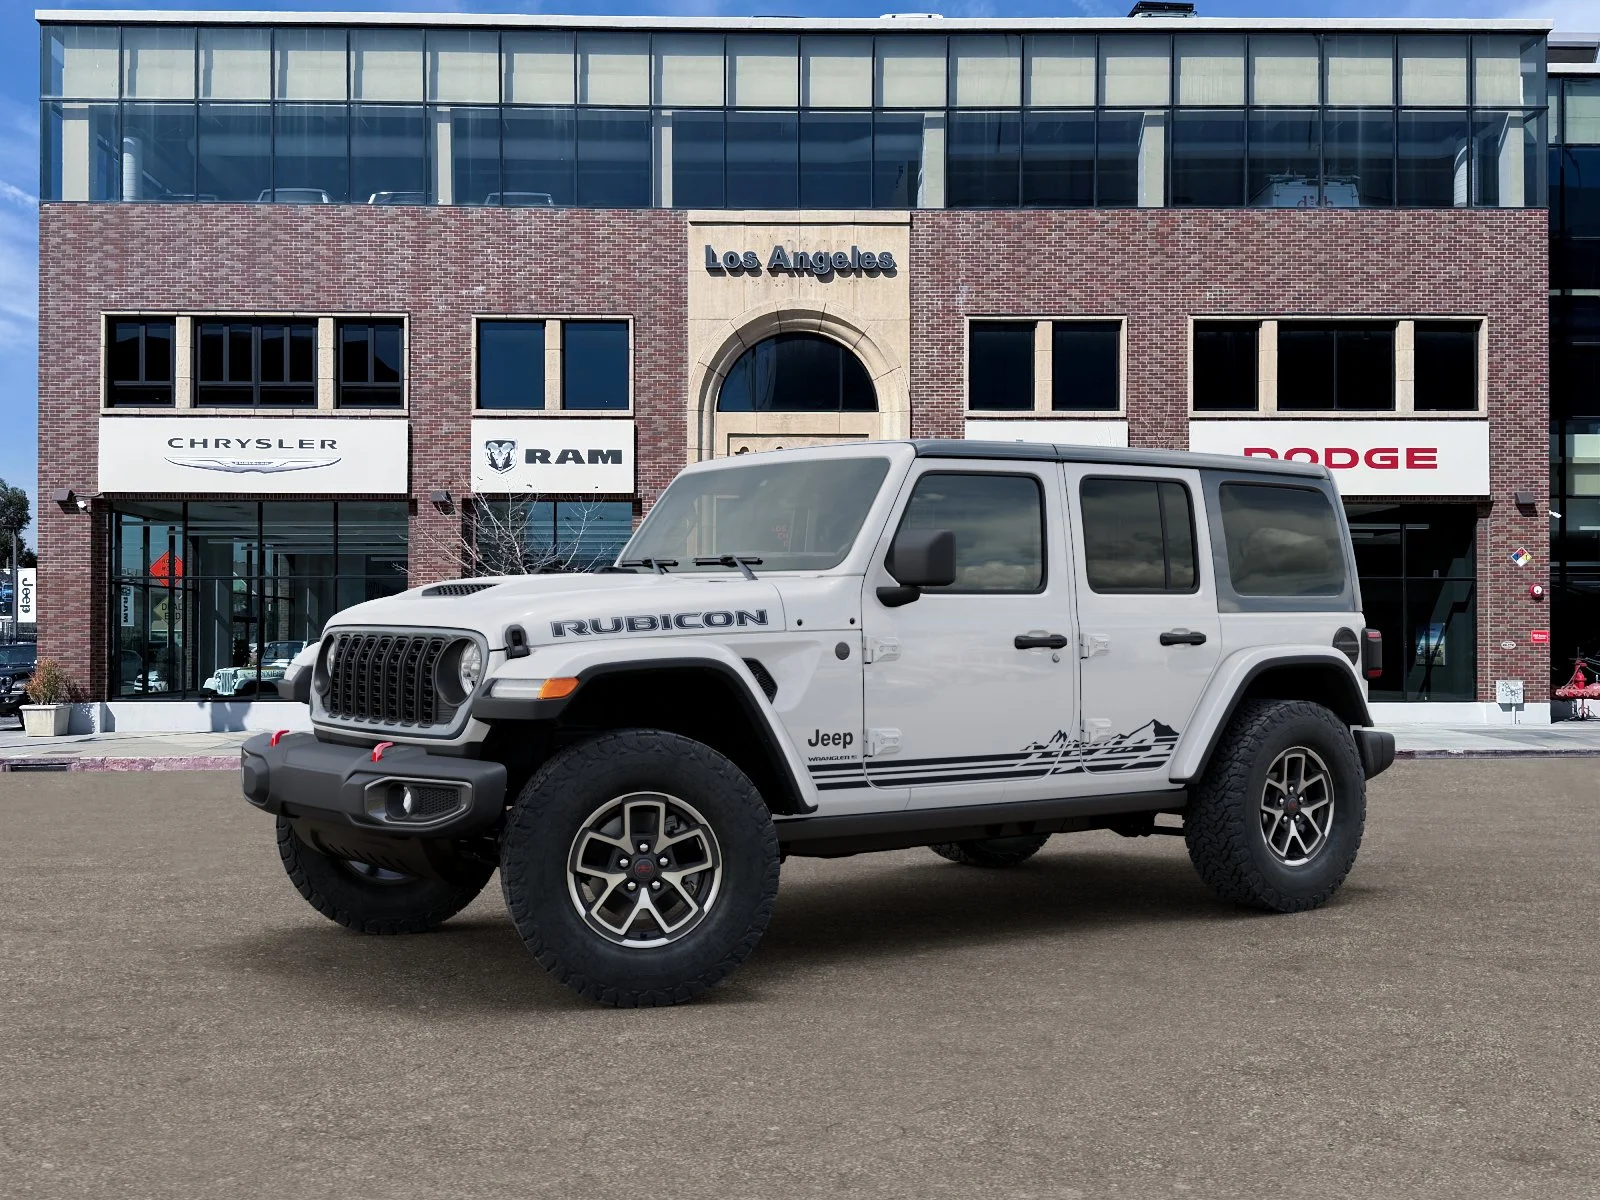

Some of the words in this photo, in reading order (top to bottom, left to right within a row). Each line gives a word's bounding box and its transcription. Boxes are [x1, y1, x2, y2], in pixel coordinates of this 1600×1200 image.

[704, 244, 760, 270] Los
[767, 244, 895, 275] Angeles
[167, 437, 338, 450] CHRYSLER
[525, 448, 623, 465] RAM
[21, 577, 34, 613] Jeep
[164, 612, 181, 620] ED
[550, 609, 769, 637] RUBICON
[807, 729, 854, 749] Jeep
